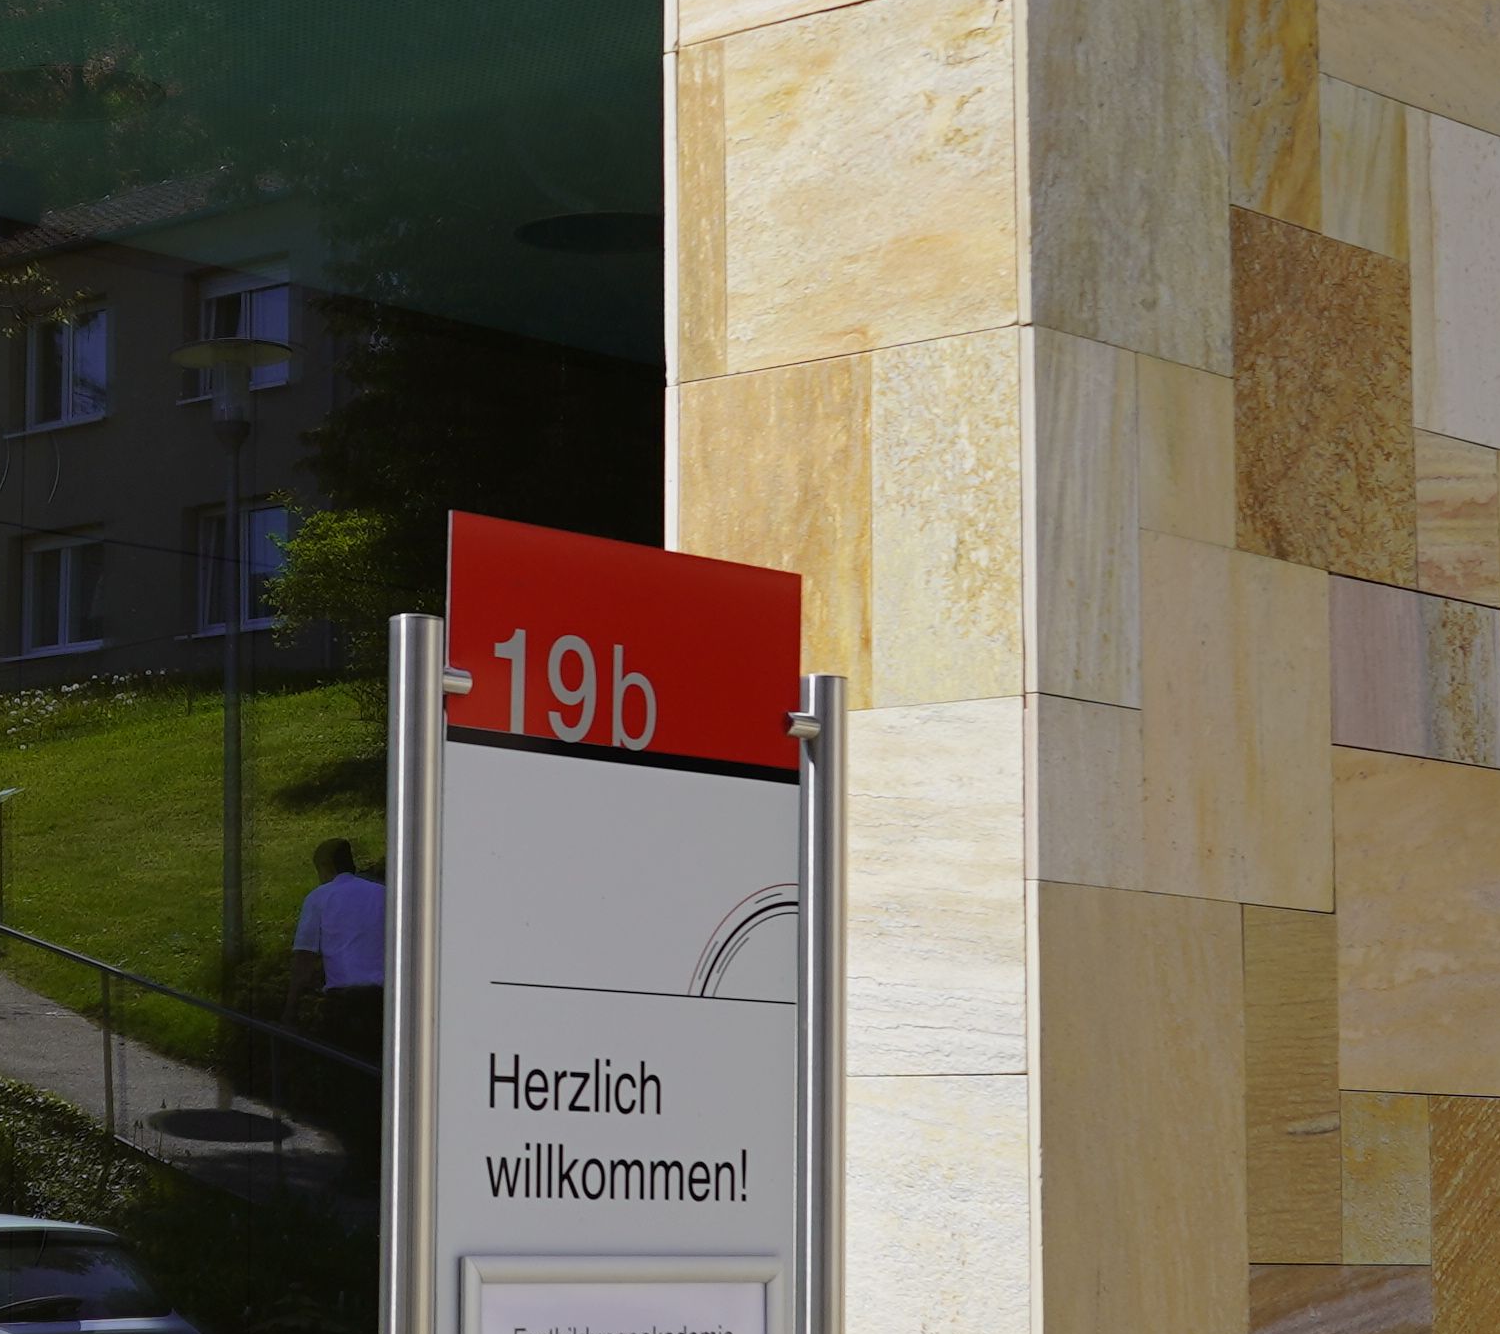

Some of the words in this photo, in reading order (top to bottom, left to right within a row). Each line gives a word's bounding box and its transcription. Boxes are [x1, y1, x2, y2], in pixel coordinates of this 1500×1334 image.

[493, 627, 658, 752] 19b
[488, 1052, 663, 1116] Herzlich
[485, 1142, 749, 1203] willkommen!
